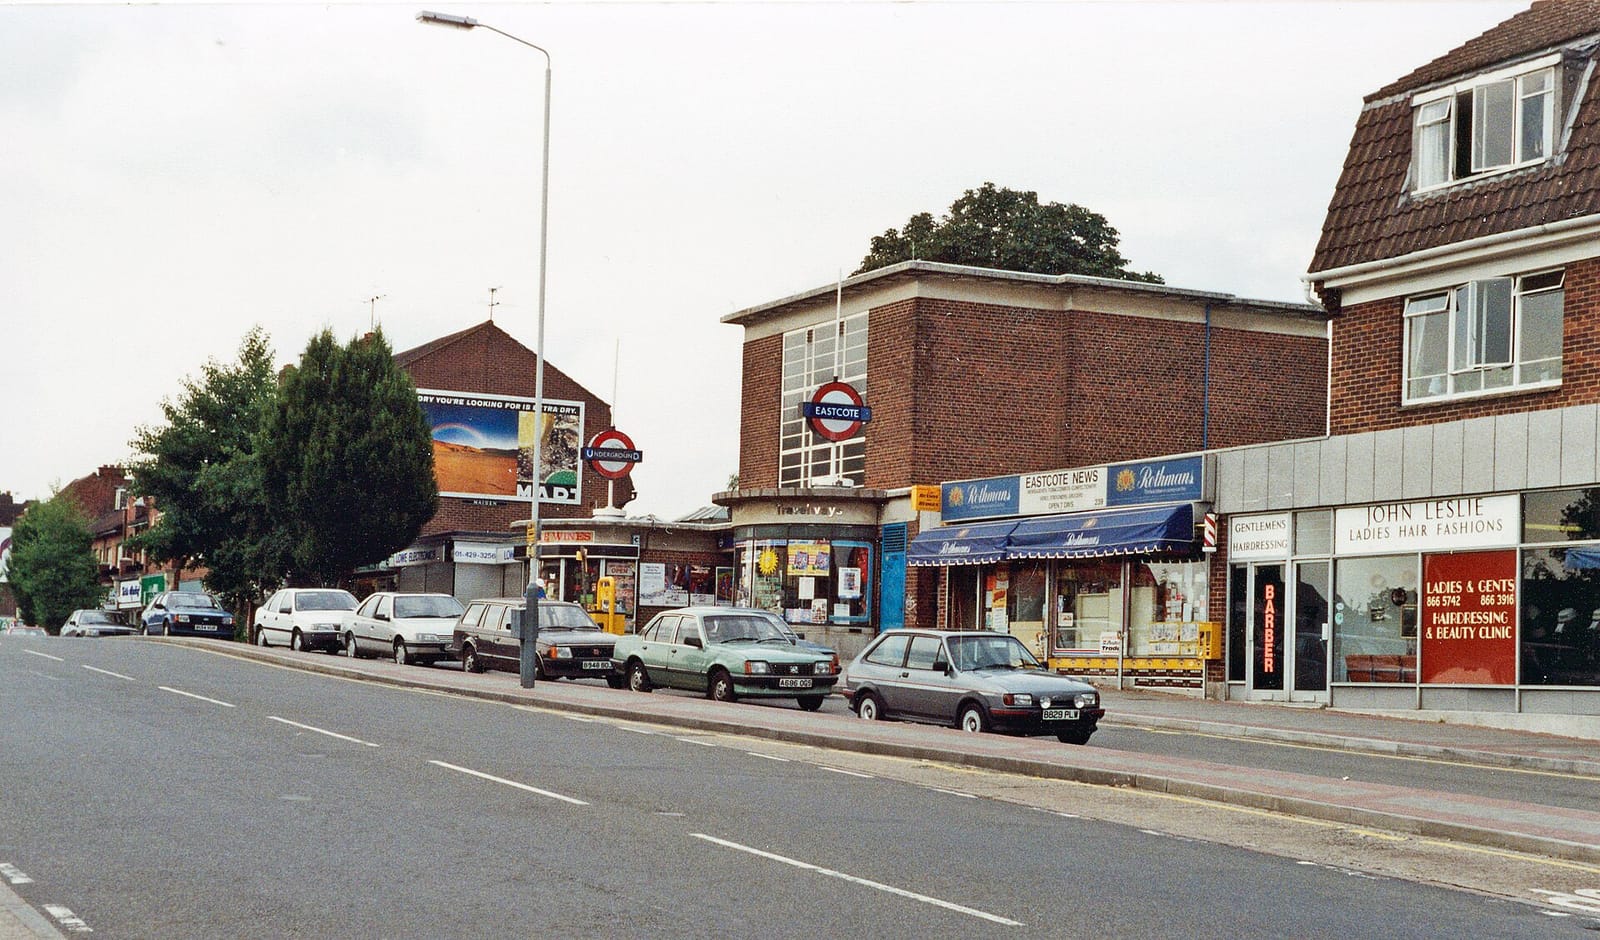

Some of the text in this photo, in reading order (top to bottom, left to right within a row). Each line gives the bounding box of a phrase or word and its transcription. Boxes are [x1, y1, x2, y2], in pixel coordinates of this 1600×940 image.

[436, 397, 465, 405] YOU'RE
[466, 399, 503, 409] LOOKING
[504, 402, 521, 410] FOR
[522, 403, 531, 411] IS
[532, 404, 559, 413] ETRA
[559, 406, 577, 415] DRY.
[815, 406, 860, 418] EASTCOTE
[586, 449, 640, 460] UNDERGROUND
[1025, 470, 1099, 489] EASTCOTE NEWS
[1137, 465, 1195, 489] Rothmans
[967, 484, 1012, 504] Rothmans
[1367, 498, 1484, 527] JOHN LESLIE
[1235, 519, 1287, 533] GENTLEMENS
[1349, 518, 1503, 541] LADIES HAIR FASHIONS
[553, 532, 591, 541] WINES
[1063, 532, 1100, 546] Rothmans
[938, 541, 971, 555] Rothmans
[1232, 539, 1288, 553] HAIRDRESSING
[1426, 578, 1515, 594] LADIES & GENTS
[1426, 593, 1514, 607] 866 5742 866 3916
[1432, 611, 1509, 625] HAIRDRESSING
[1264, 584, 1275, 673] BARBER
[1425, 626, 1512, 640] & BEAUTY CLINIC
